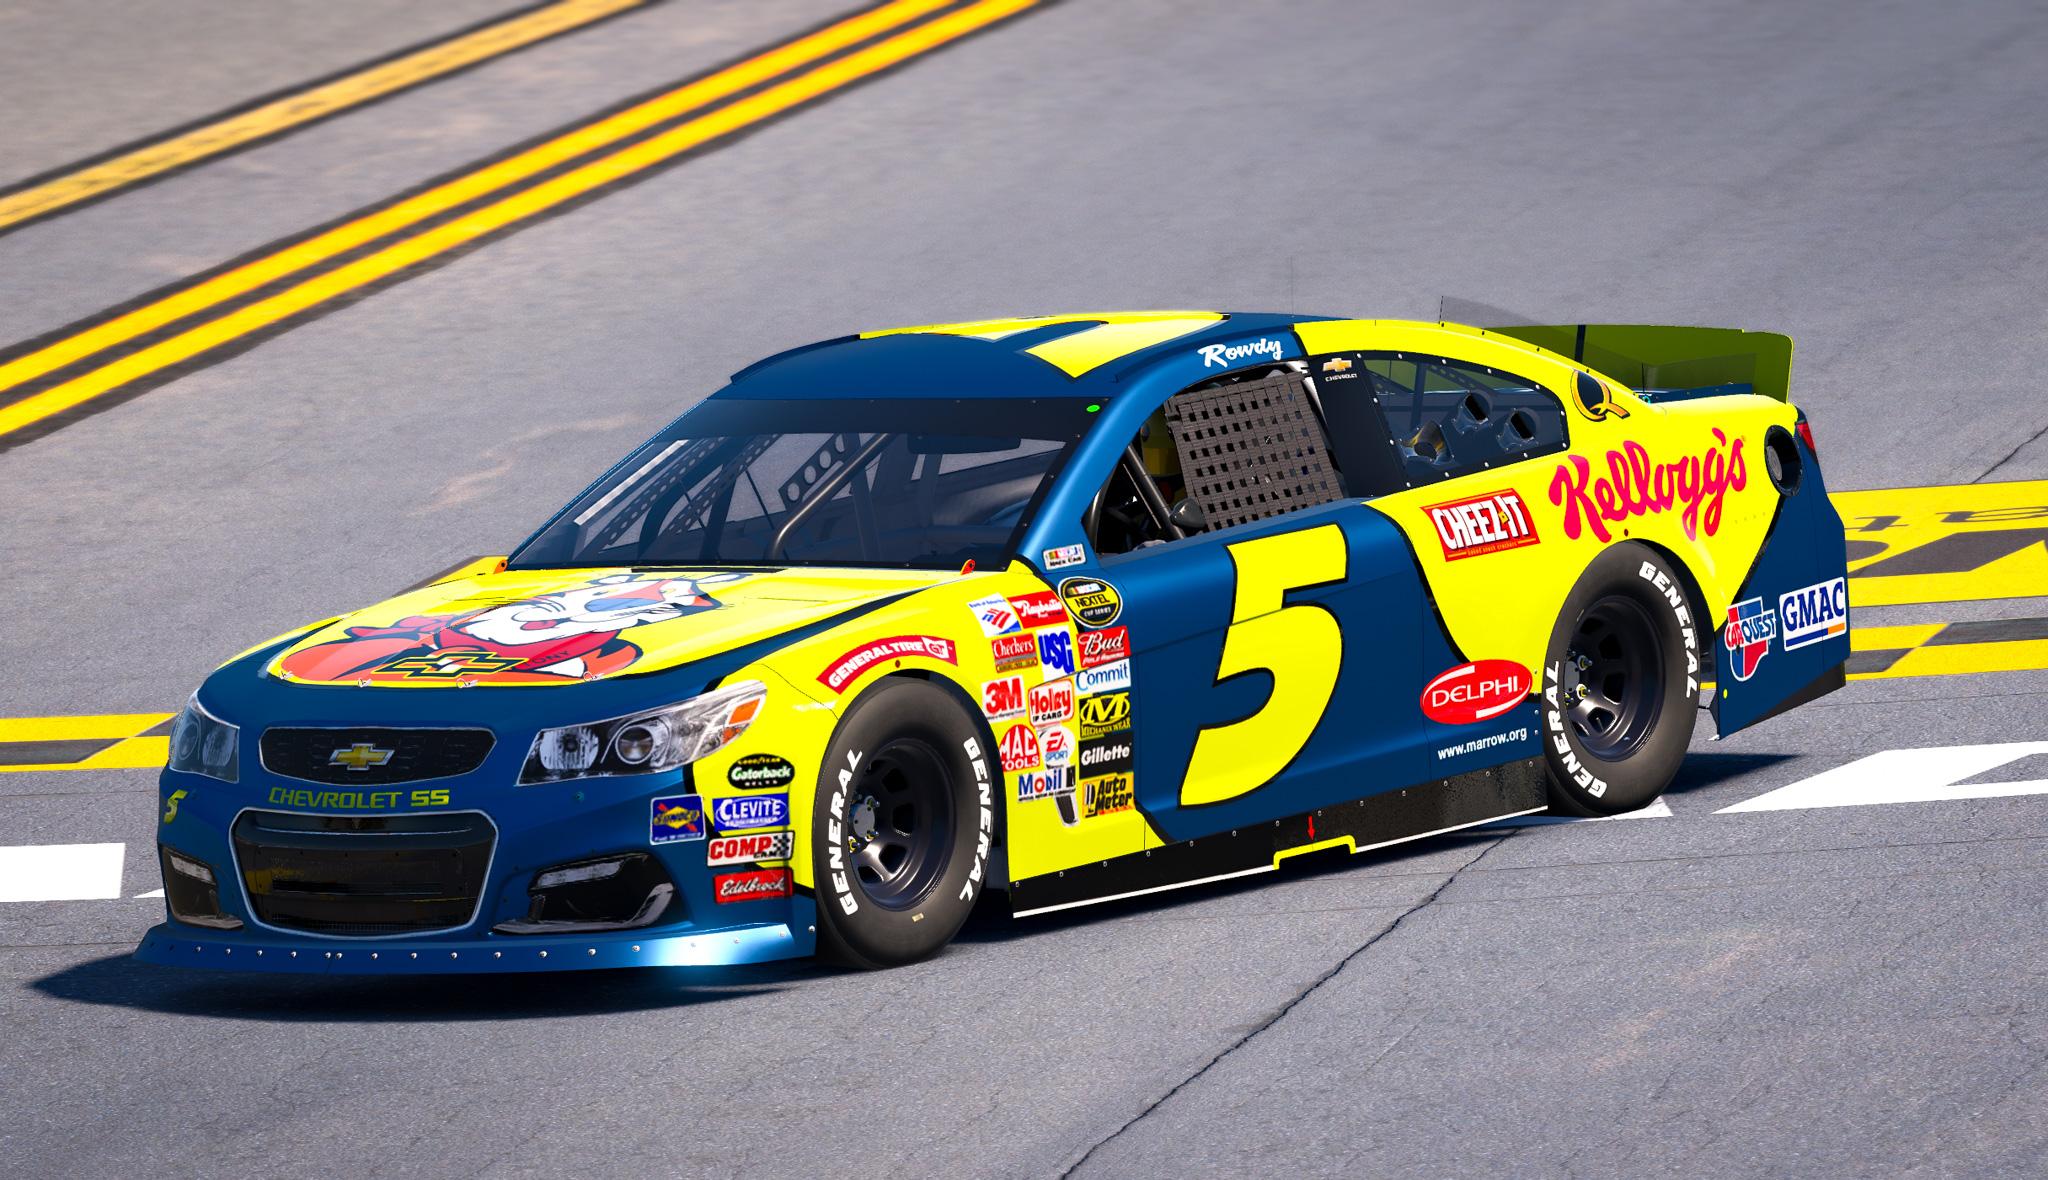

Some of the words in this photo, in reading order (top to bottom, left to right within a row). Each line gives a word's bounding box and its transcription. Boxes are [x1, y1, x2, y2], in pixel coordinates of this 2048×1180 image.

[1197, 338, 1284, 368] Rowdy
[1548, 427, 1747, 543] Kellogg's
[1074, 594, 1110, 608] NEXTEL
[1782, 581, 1844, 632] GMAC
[1078, 629, 1125, 656] Bud
[1638, 560, 1698, 698] GENERAL
[993, 637, 1033, 658] Checkers
[1038, 631, 1075, 675] USG
[828, 643, 893, 688] GENERAL
[890, 641, 925, 652] TIRE
[1076, 662, 1128, 691] Commit
[1177, 522, 1349, 809] 5
[986, 678, 1022, 715] 3M
[1432, 675, 1519, 708] DELPHI
[999, 726, 1037, 759] MAC
[1438, 727, 1527, 760] www.marrow.org
[1545, 661, 1608, 799] GENERAL
[1002, 755, 1039, 770] OOLS
[1081, 744, 1130, 766] Gillette
[731, 765, 792, 781] Gatorback
[1019, 768, 1061, 796] Mobil
[1098, 777, 1126, 795] Auto
[164, 789, 189, 824] 5
[268, 787, 403, 809] CHEVROLET
[410, 789, 450, 807] SS
[720, 799, 781, 821] CLEVITE
[1096, 792, 1132, 811] Meter
[828, 749, 863, 915] GENERAL
[958, 736, 992, 901] GENERAL
[709, 836, 773, 860] COMP
[720, 876, 785, 897] Edelbrock
